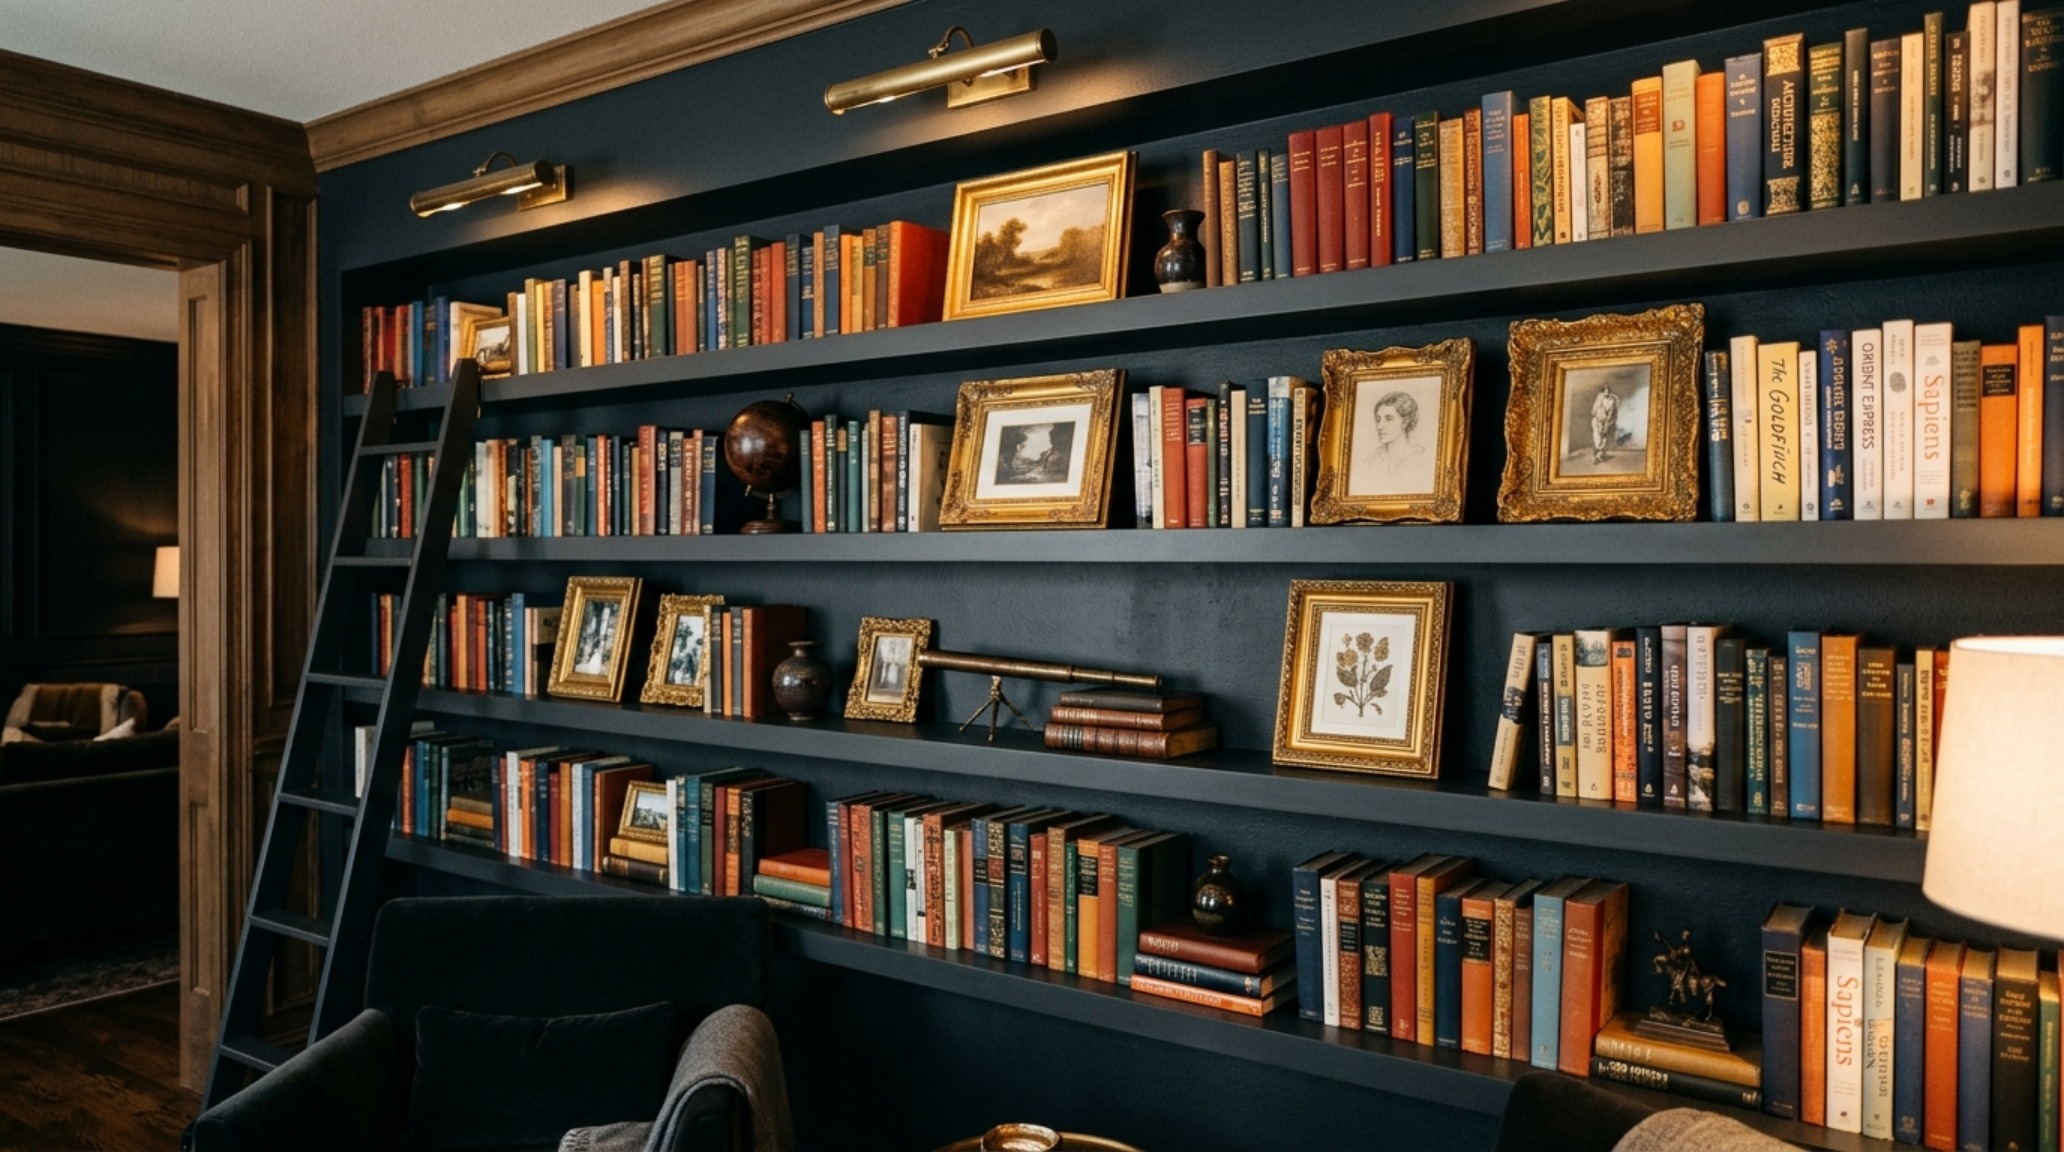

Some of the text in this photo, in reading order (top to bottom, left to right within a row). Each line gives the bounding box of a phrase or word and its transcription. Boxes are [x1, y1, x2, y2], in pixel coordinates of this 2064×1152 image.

[1771, 358, 1787, 383] The
[1917, 375, 1946, 460] Sapiens
[1831, 975, 1861, 1066] Sapiens
